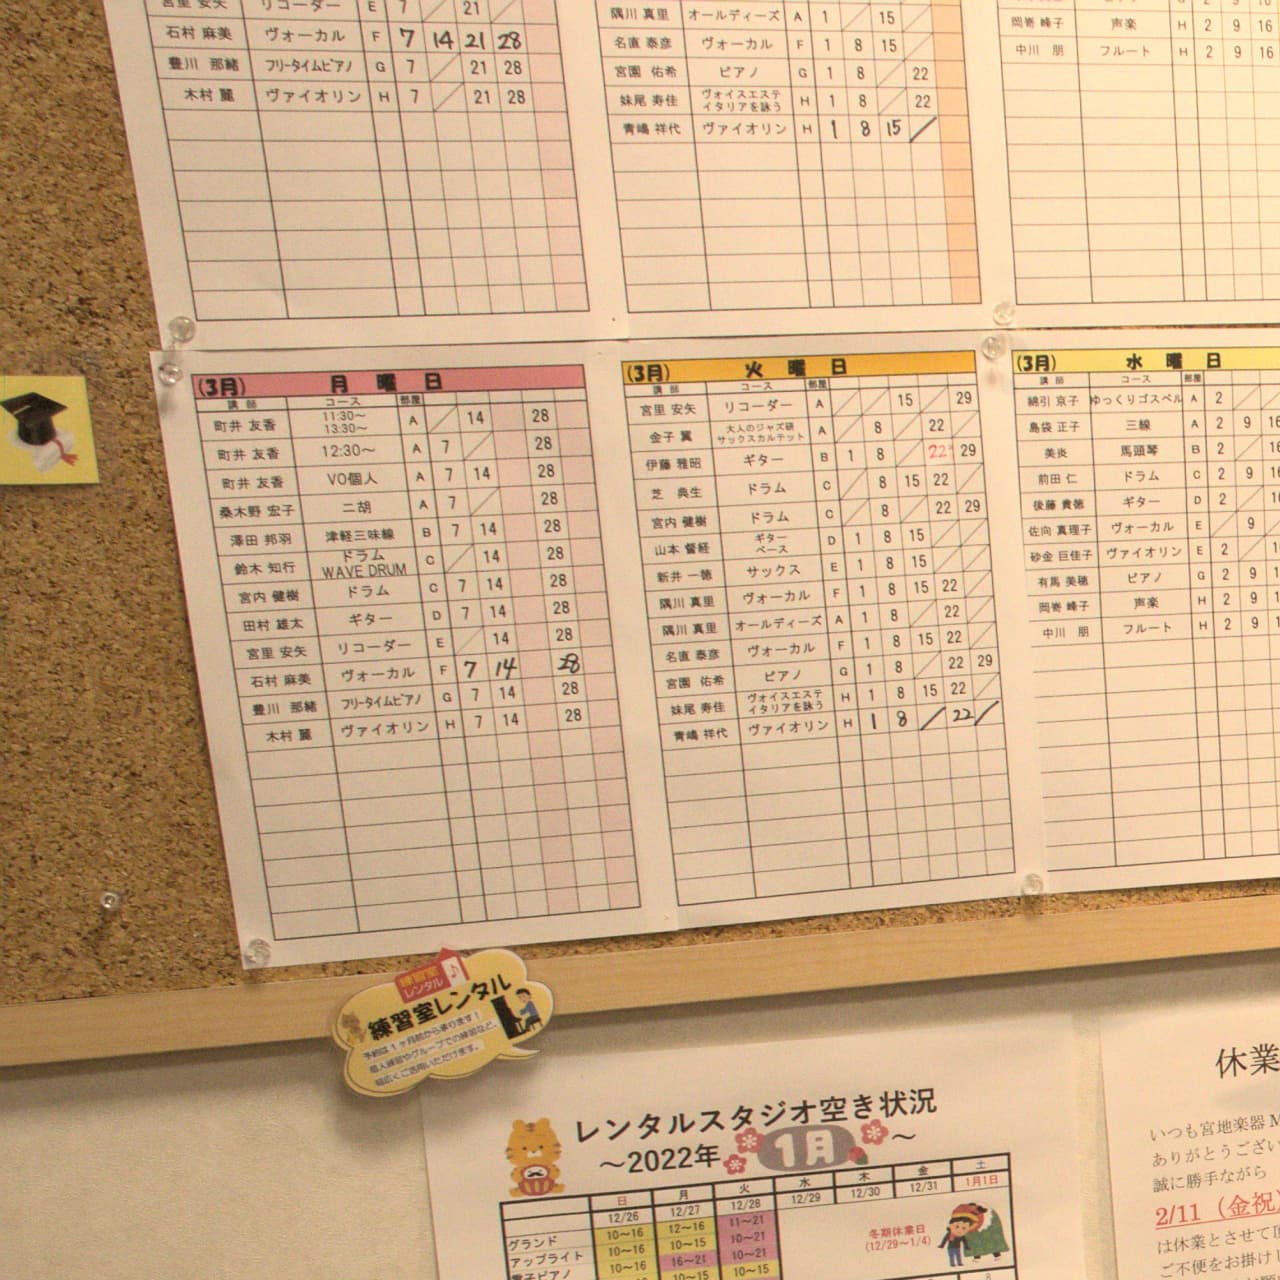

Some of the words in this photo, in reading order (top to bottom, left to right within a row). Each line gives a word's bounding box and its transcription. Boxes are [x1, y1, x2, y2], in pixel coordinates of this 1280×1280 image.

[688, 9, 780, 23] オールディーズ
[166, 26, 195, 41] 石村
[203, 26, 232, 40] 麻美
[265, 29, 345, 43] ヴォーカル
[372, 31, 380, 43] F
[400, 29, 414, 49] 7
[433, 30, 453, 50] 14
[466, 31, 486, 50] 21
[498, 31, 522, 50] 28
[702, 38, 772, 50] ヴォーカル
[1099, 44, 1150, 57] フルート
[184, 88, 213, 103] 木村
[266, 89, 362, 104] ヴァイオリン
[724, 400, 793, 412] リコーダー
[956, 392, 972, 404] 29
[218, 448, 248, 461] 町井
[253, 447, 280, 460] 友香
[536, 437, 552, 450] 28
[325, 529, 395, 542] 津軽三味線
[1106, 547, 1182, 560] ヴァイオリン
[323, 565, 364, 579] WAVE
[369, 563, 407, 576] DRUM
[735, 614, 822, 631] オールディーズ
[464, 662, 476, 678] 7
[495, 658, 517, 680] 14
[558, 654, 580, 672] 28
[368, 974, 511, 1041] 練習室レンタル
[576, 1088, 937, 1144] レンタルスタジオ空き状況
[1149, 1113, 1265, 1143] いつも宮地楽器
[1153, 1164, 1268, 1193] 誠に勝手ながら
[607, 1211, 640, 1225] 12/26
[730, 1198, 762, 1212] 12/28
[868, 1224, 927, 1240] 冬期休業日
[508, 1236, 557, 1251] グランド
[509, 1250, 584, 1268] アップライト
